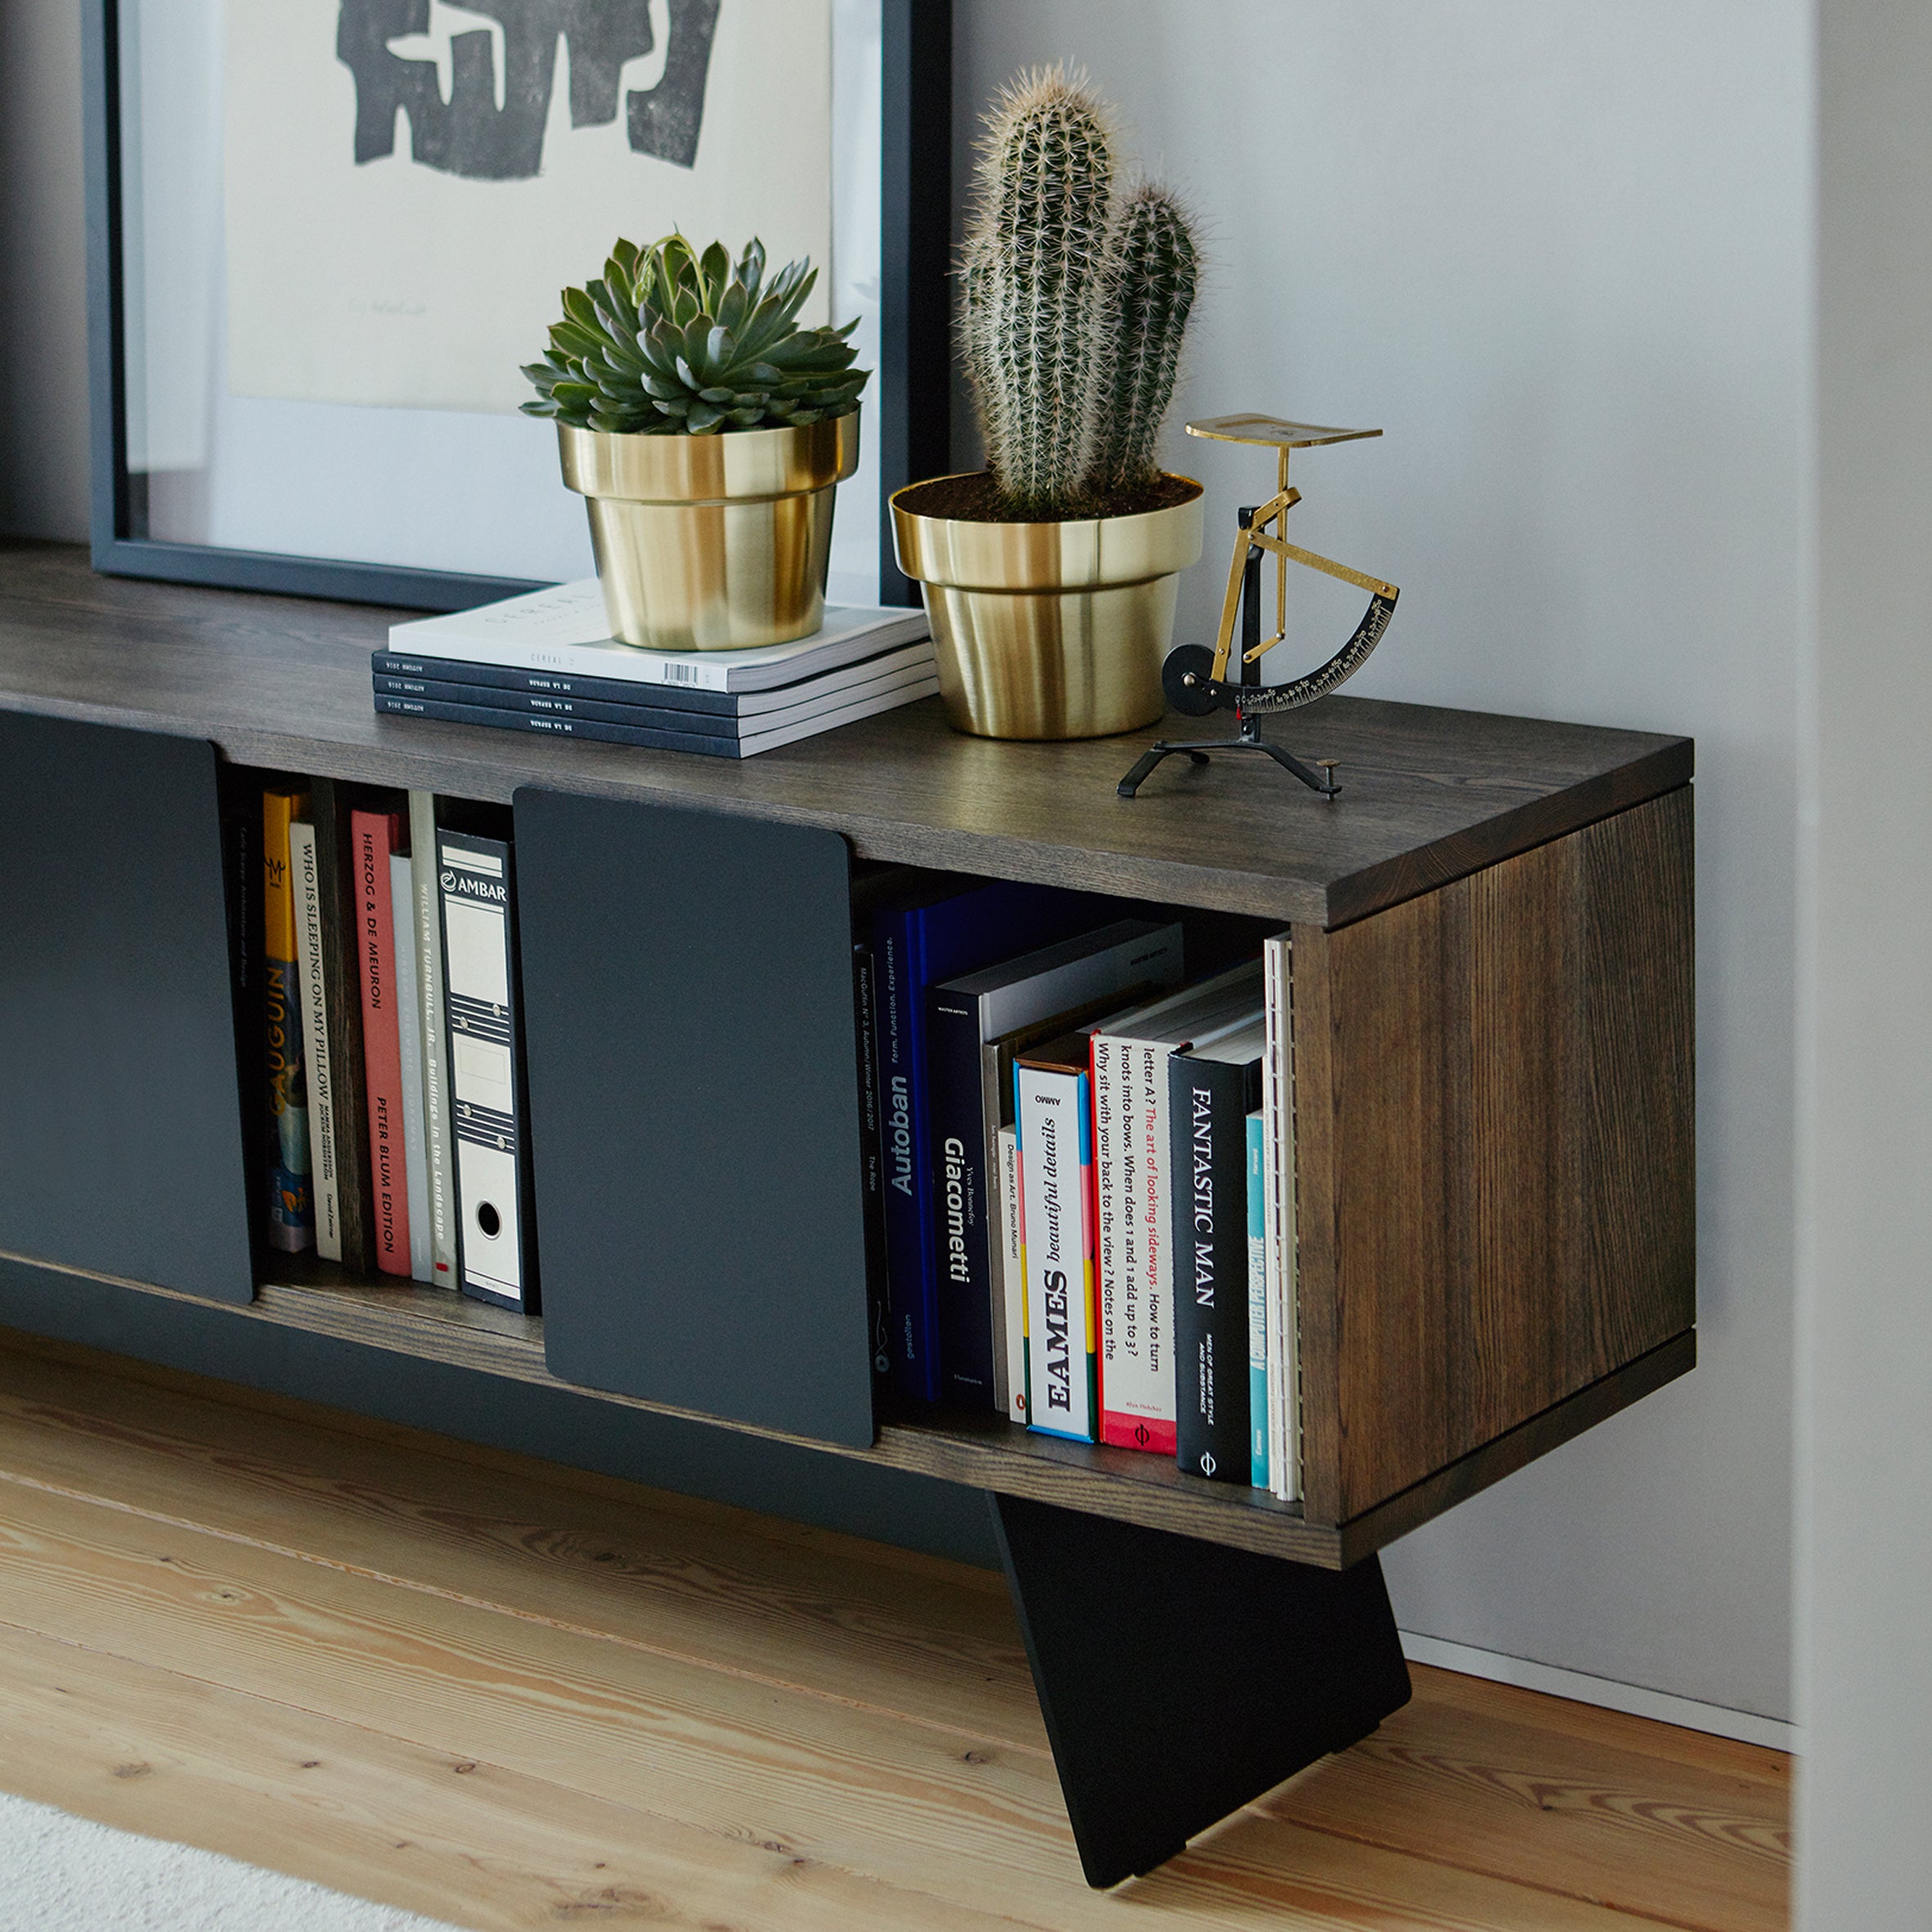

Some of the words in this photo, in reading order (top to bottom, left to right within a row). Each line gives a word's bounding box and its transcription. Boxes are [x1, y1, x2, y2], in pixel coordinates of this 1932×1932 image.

[303, 843, 315, 883] WHO
[362, 833, 375, 896] HERZOG
[306, 887, 317, 901] IS
[458, 877, 507, 902] AMBAR
[366, 901, 376, 912] &
[420, 883, 431, 942] WILLIAM
[308, 904, 321, 982] SLEEPING
[367, 917, 377, 938] DE
[368, 941, 381, 1010] MEURON
[423, 948, 436, 1022] TURNBULL,
[312, 984, 323, 1013] ON
[313, 1013, 326, 1037] MY
[427, 1023, 436, 1047] JR.
[267, 967, 285, 1116] GAUGUIN
[1096, 1042, 1109, 1072] Why
[316, 1039, 329, 1101] PILLOW
[1121, 1044, 1132, 1082] knots
[1143, 1048, 1155, 1085] letter
[429, 1058, 438, 1120] Buildings
[1099, 1075, 1110, 1091] sit
[1122, 1085, 1133, 1112] into
[865, 1090, 874, 1131] 2016/2017
[1035, 1095, 1061, 1107] AMMO
[1099, 1094, 1112, 1125] with
[377, 1097, 389, 1139] PETER
[432, 1124, 440, 1139] in
[1122, 1115, 1134, 1152] bows.
[1145, 1108, 1157, 1131] The
[888, 1076, 913, 1197] Autoban
[1042, 1117, 1058, 1179] details
[1098, 1126, 1111, 1158] your
[1145, 1134, 1157, 1153] art
[380, 1145, 391, 1187] BLUM
[432, 1143, 441, 1165] the
[1146, 1157, 1158, 1172] of
[1192, 1086, 1214, 1234] FANTASTIC
[1008, 1174, 1014, 1183] as
[1102, 1161, 1113, 1192] back
[1124, 1155, 1135, 1193] When
[434, 1170, 445, 1241] Landscape
[945, 1138, 970, 1283] Giacometti
[967, 1188, 976, 1226] Bonnefoy
[1102, 1194, 1113, 1209] to
[1125, 1195, 1136, 1227] does
[1145, 1175, 1158, 1224] looking
[382, 1193, 394, 1253] EDITION
[1043, 1180, 1063, 1264] beautiful
[1103, 1212, 1114, 1233] the
[1126, 1238, 1137, 1264] and
[1146, 1227, 1160, 1291] sideways.
[1194, 1241, 1215, 1309] MAN
[1248, 1236, 1265, 1303] PERSPECTIVE
[1103, 1278, 1115, 1316] Notes
[1126, 1274, 1138, 1301] add
[1124, 1304, 1135, 1323] up
[1149, 1293, 1160, 1324] How
[1043, 1269, 1072, 1413] EAMES
[1104, 1319, 1114, 1336] on
[1126, 1324, 1138, 1339] to
[1150, 1326, 1161, 1341] to
[1249, 1306, 1266, 1360] COMPUTER
[1105, 1339, 1117, 1361] the
[1150, 1343, 1161, 1373] turn
[1206, 1354, 1213, 1367] OF
[1250, 1359, 1265, 1371] A
